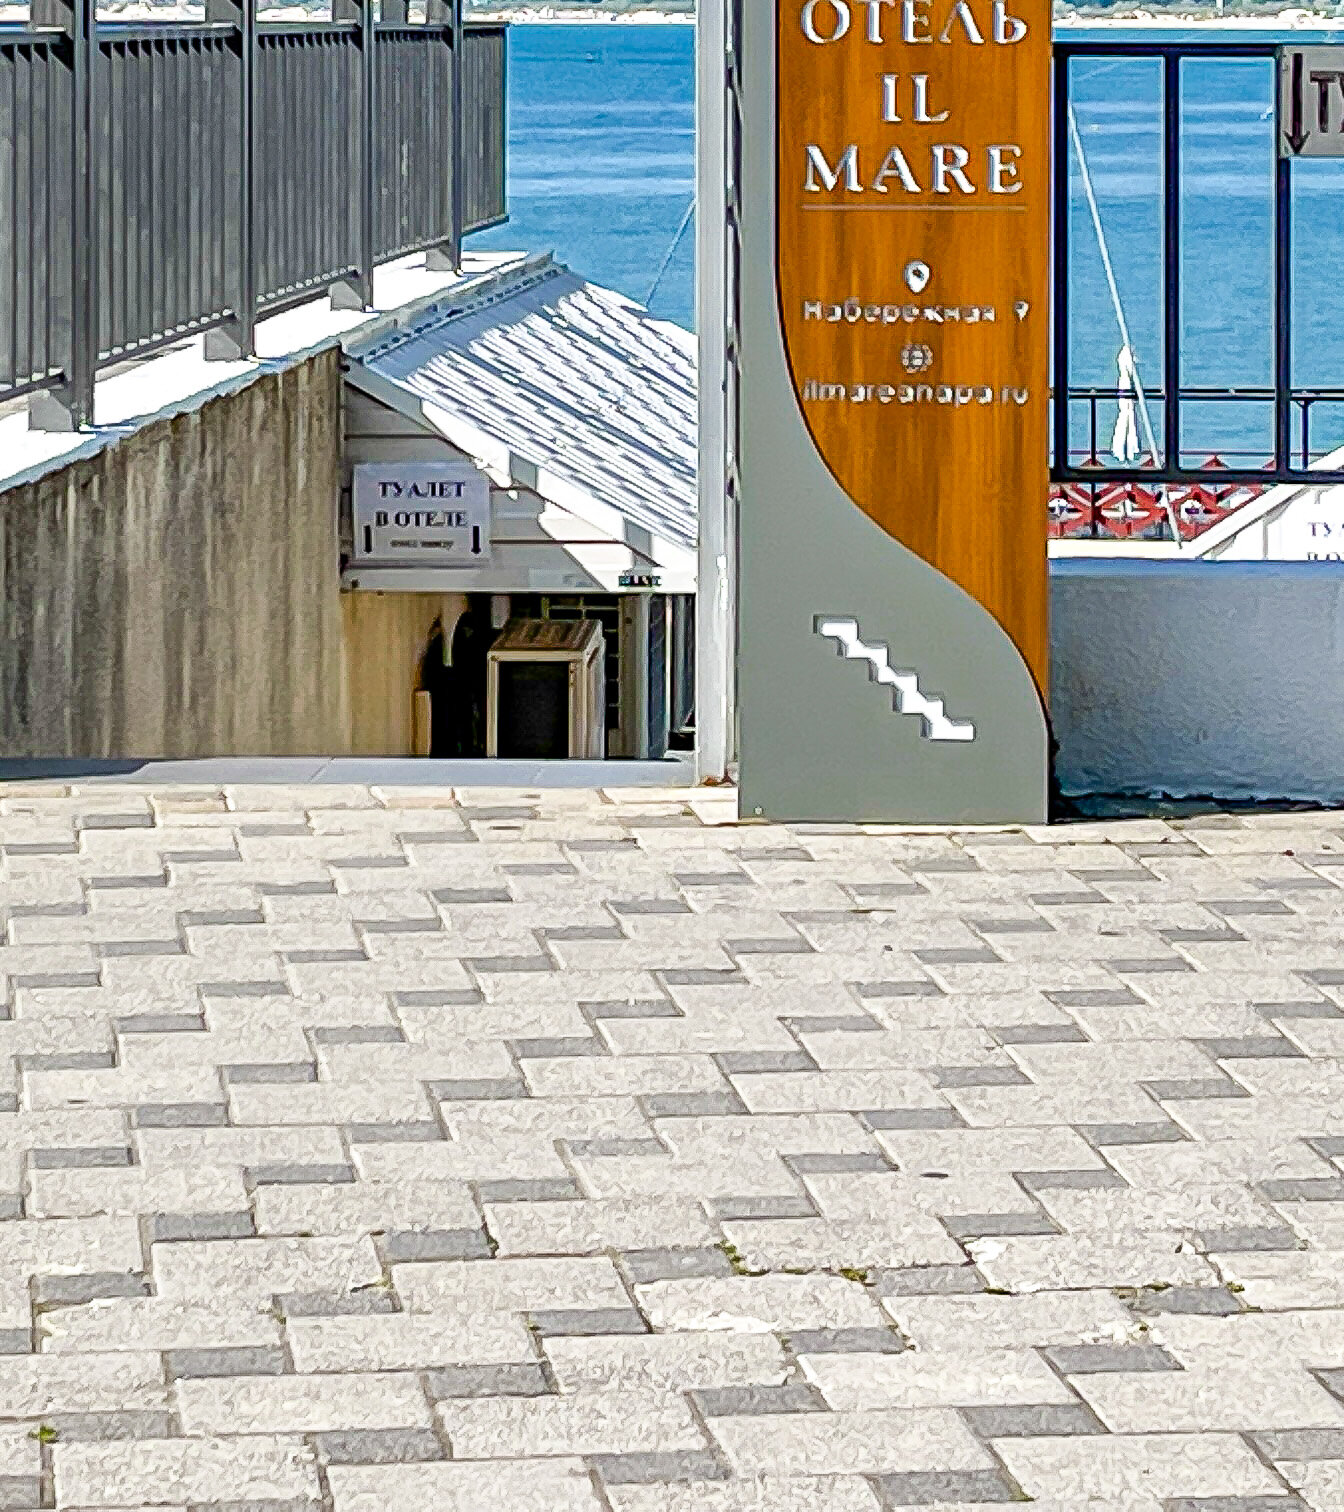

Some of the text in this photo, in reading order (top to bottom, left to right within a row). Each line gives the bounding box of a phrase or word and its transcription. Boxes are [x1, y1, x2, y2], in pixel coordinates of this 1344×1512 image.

[881, 74, 951, 124] IL
[805, 144, 1024, 194] MARE
[803, 297, 996, 325] Набережная
[378, 481, 466, 498] ТУАЛЕТ
[376, 511, 468, 527] В ОТЕЛЕ
